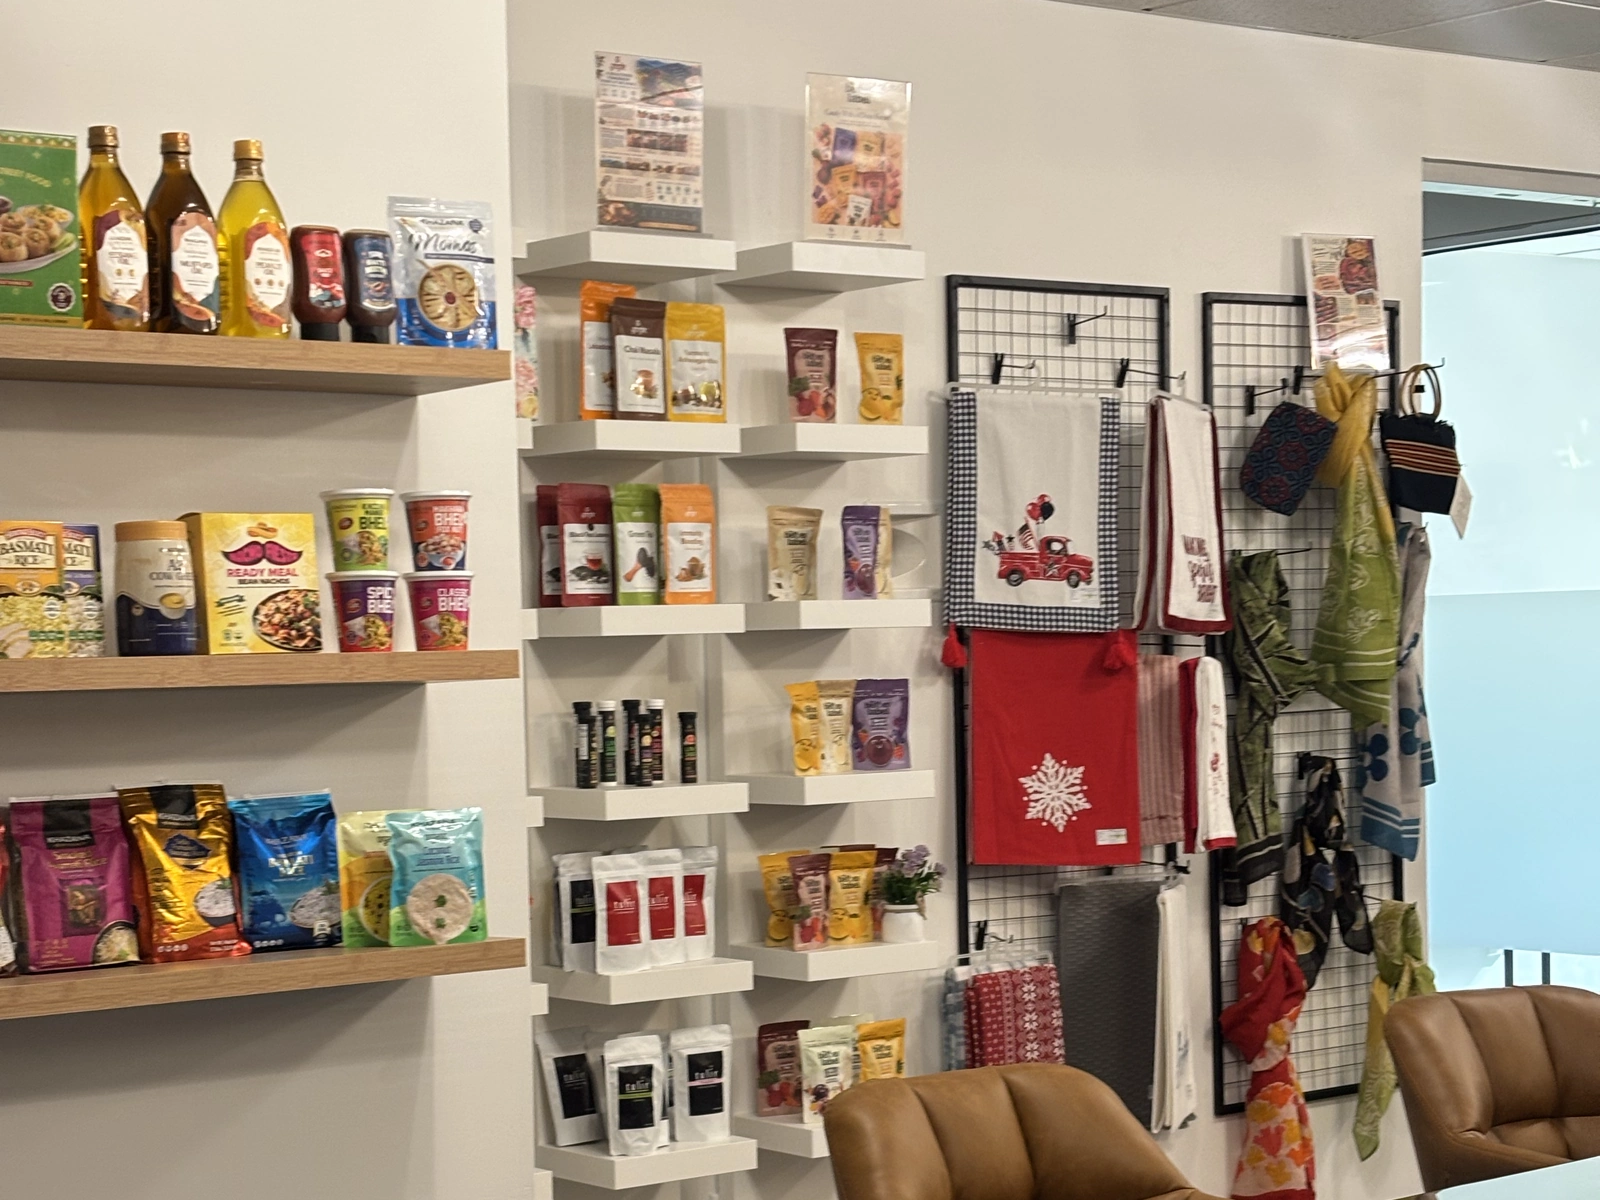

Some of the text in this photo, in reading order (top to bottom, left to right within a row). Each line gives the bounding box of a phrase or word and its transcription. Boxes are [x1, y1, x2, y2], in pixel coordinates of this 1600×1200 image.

[226, 568, 299, 578] READY MEAL
[366, 586, 394, 599] SPIC
